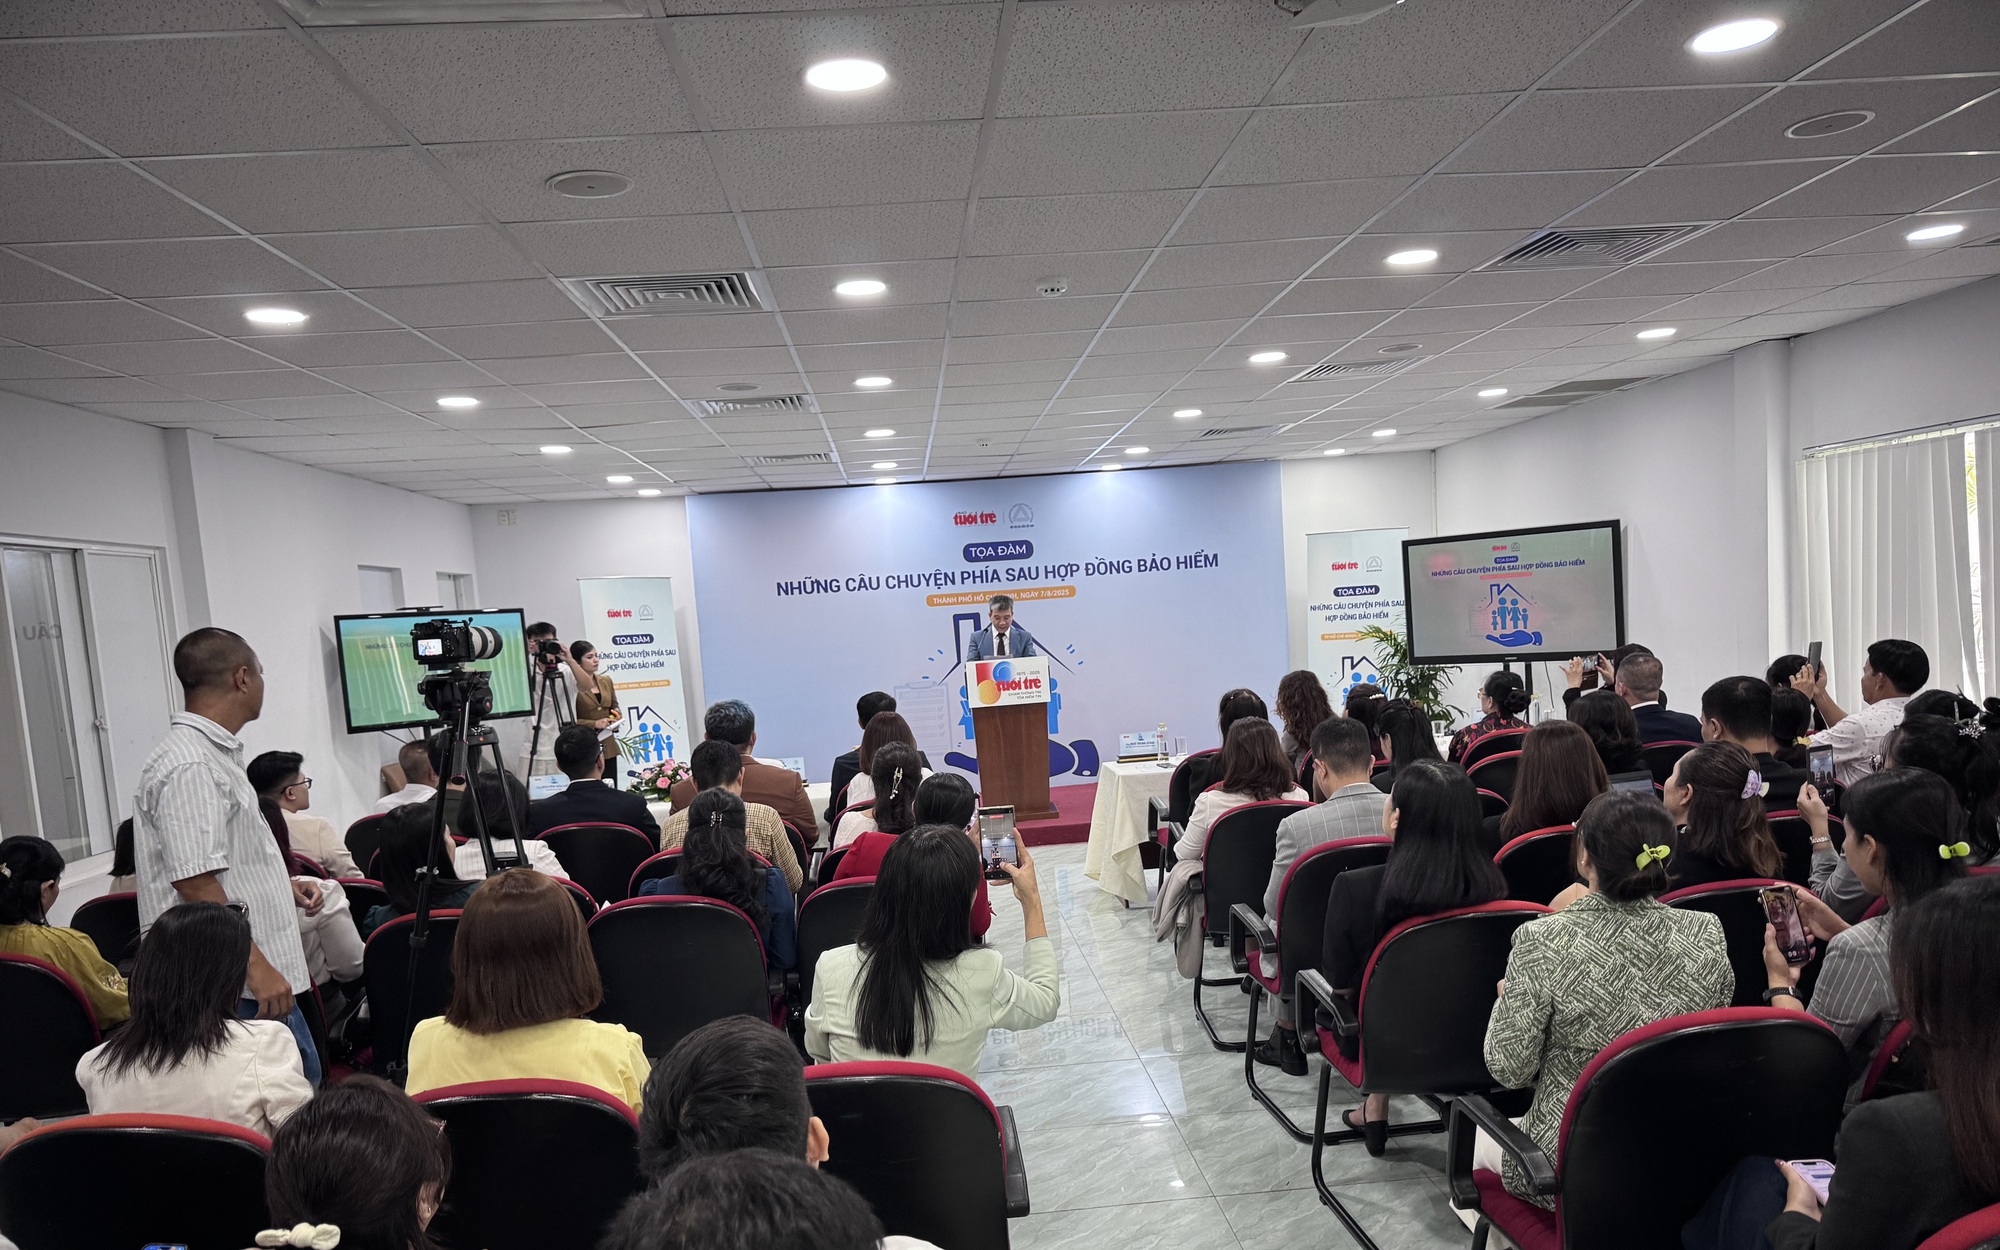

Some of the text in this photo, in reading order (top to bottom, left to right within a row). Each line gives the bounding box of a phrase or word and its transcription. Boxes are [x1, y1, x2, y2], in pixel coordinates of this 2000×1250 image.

[969, 543, 1026, 559] TỌA ĐÀM
[1466, 566, 1490, 574] CHUYỆN
[1535, 561, 1553, 569] ĐỒNG
[1554, 560, 1568, 568] BẢO
[1568, 558, 1586, 566] HIỂM
[776, 549, 1219, 596] NHỮNG CÂU CHUYỆN PHÍA SAU HỢP ĐỒNG BẢO HIỂM
[933, 596, 957, 604] THÀNH
[958, 594, 972, 604] PHỐ
[974, 594, 984, 602] HỒ
[1040, 588, 1070, 598] 7/8/2025
[1337, 586, 1376, 596] TỌA ĐÀM
[1310, 603, 1332, 611] NHỮNG
[1334, 602, 1346, 610] CÂU
[1348, 601, 1373, 609] CHUYỆN
[1374, 599, 1390, 608] PHÍA
[1340, 612, 1357, 620] ĐỒNG
[1358, 612, 1371, 620] BẢO
[1372, 610, 1389, 619] HIỂM
[616, 635, 650, 645] TỌA ĐÀM
[598, 652, 613, 660] HỮNG
[614, 650, 626, 659] CÂU
[627, 649, 650, 658] CHUYỆN
[651, 648, 664, 656] PHÍA
[607, 659, 664, 672] HỢP ĐỒNG BẢO HIỂM
